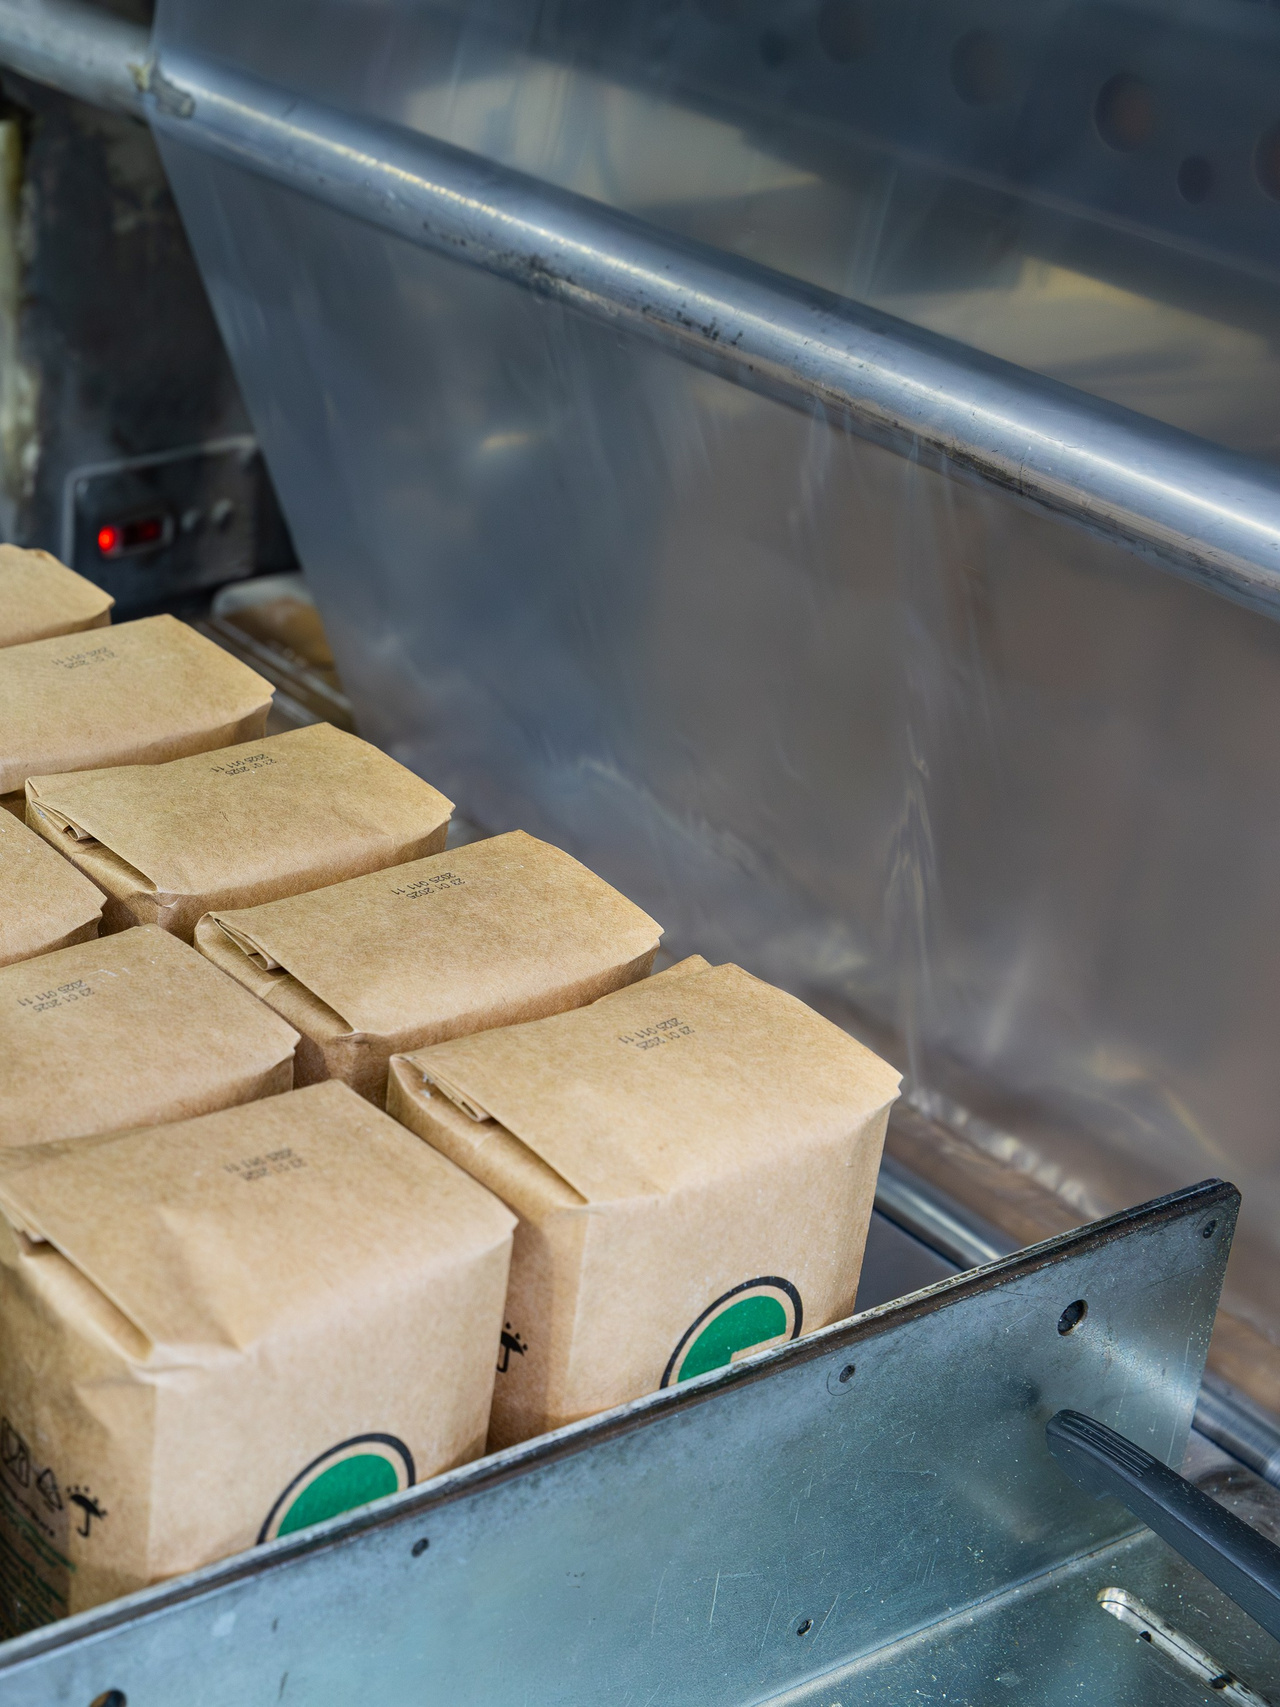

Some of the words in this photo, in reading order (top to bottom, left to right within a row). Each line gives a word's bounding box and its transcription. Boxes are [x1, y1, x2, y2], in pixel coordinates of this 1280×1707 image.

[428, 872, 457, 883] 2025
[450, 877, 466, 886] 23
[406, 880, 430, 890] 011
[434, 882, 451, 890] 01
[390, 887, 406, 895] 11
[406, 887, 435, 899] 2025
[57, 979, 87, 993] 2025
[35, 990, 58, 1001] 011
[79, 987, 95, 997] 23
[17, 998, 33, 1007] 11
[62, 993, 79, 1003] 01
[32, 999, 62, 1012] 2025
[656, 1017, 684, 1031] 2025
[634, 1027, 658, 1039] 011
[664, 1031, 681, 1040] 01
[679, 1025, 695, 1036] 23
[618, 1035, 635, 1045] 11
[636, 1036, 666, 1050] 2025
